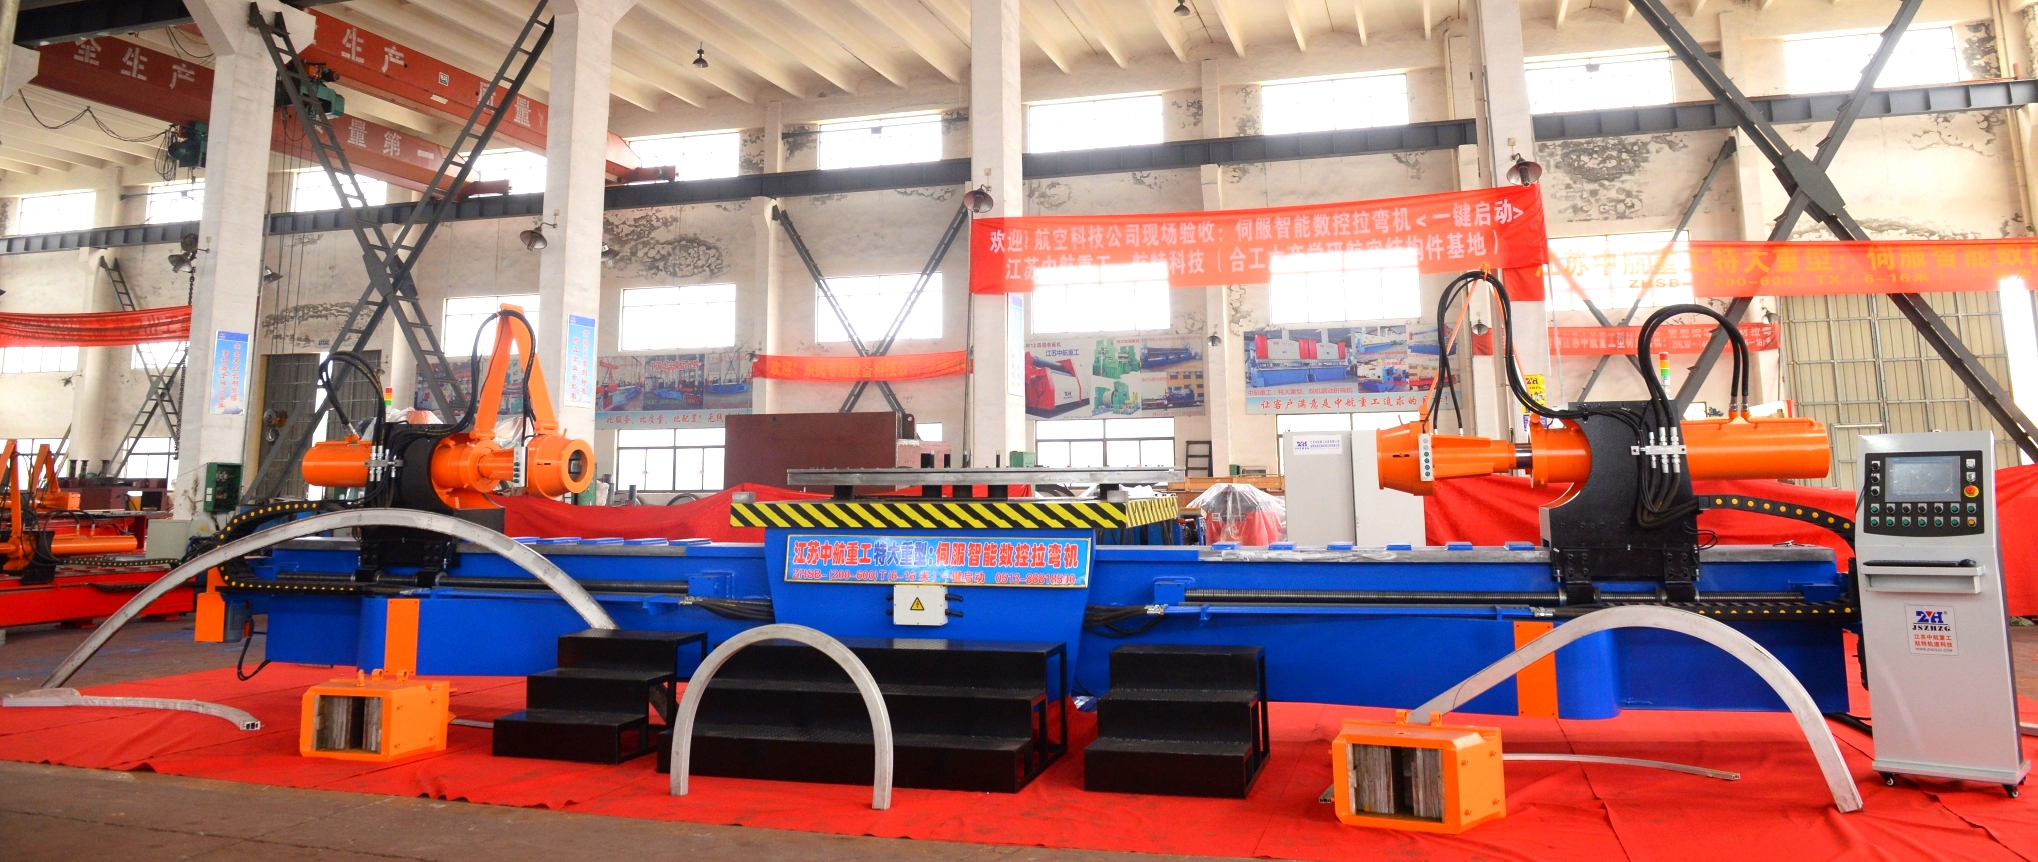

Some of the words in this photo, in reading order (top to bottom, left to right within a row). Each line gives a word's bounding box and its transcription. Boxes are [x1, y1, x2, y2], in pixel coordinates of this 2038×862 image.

[1045, 349, 1080, 357] 江苏中航重工
[1261, 396, 1450, 410] 让客户满意是中航重工追求的！
